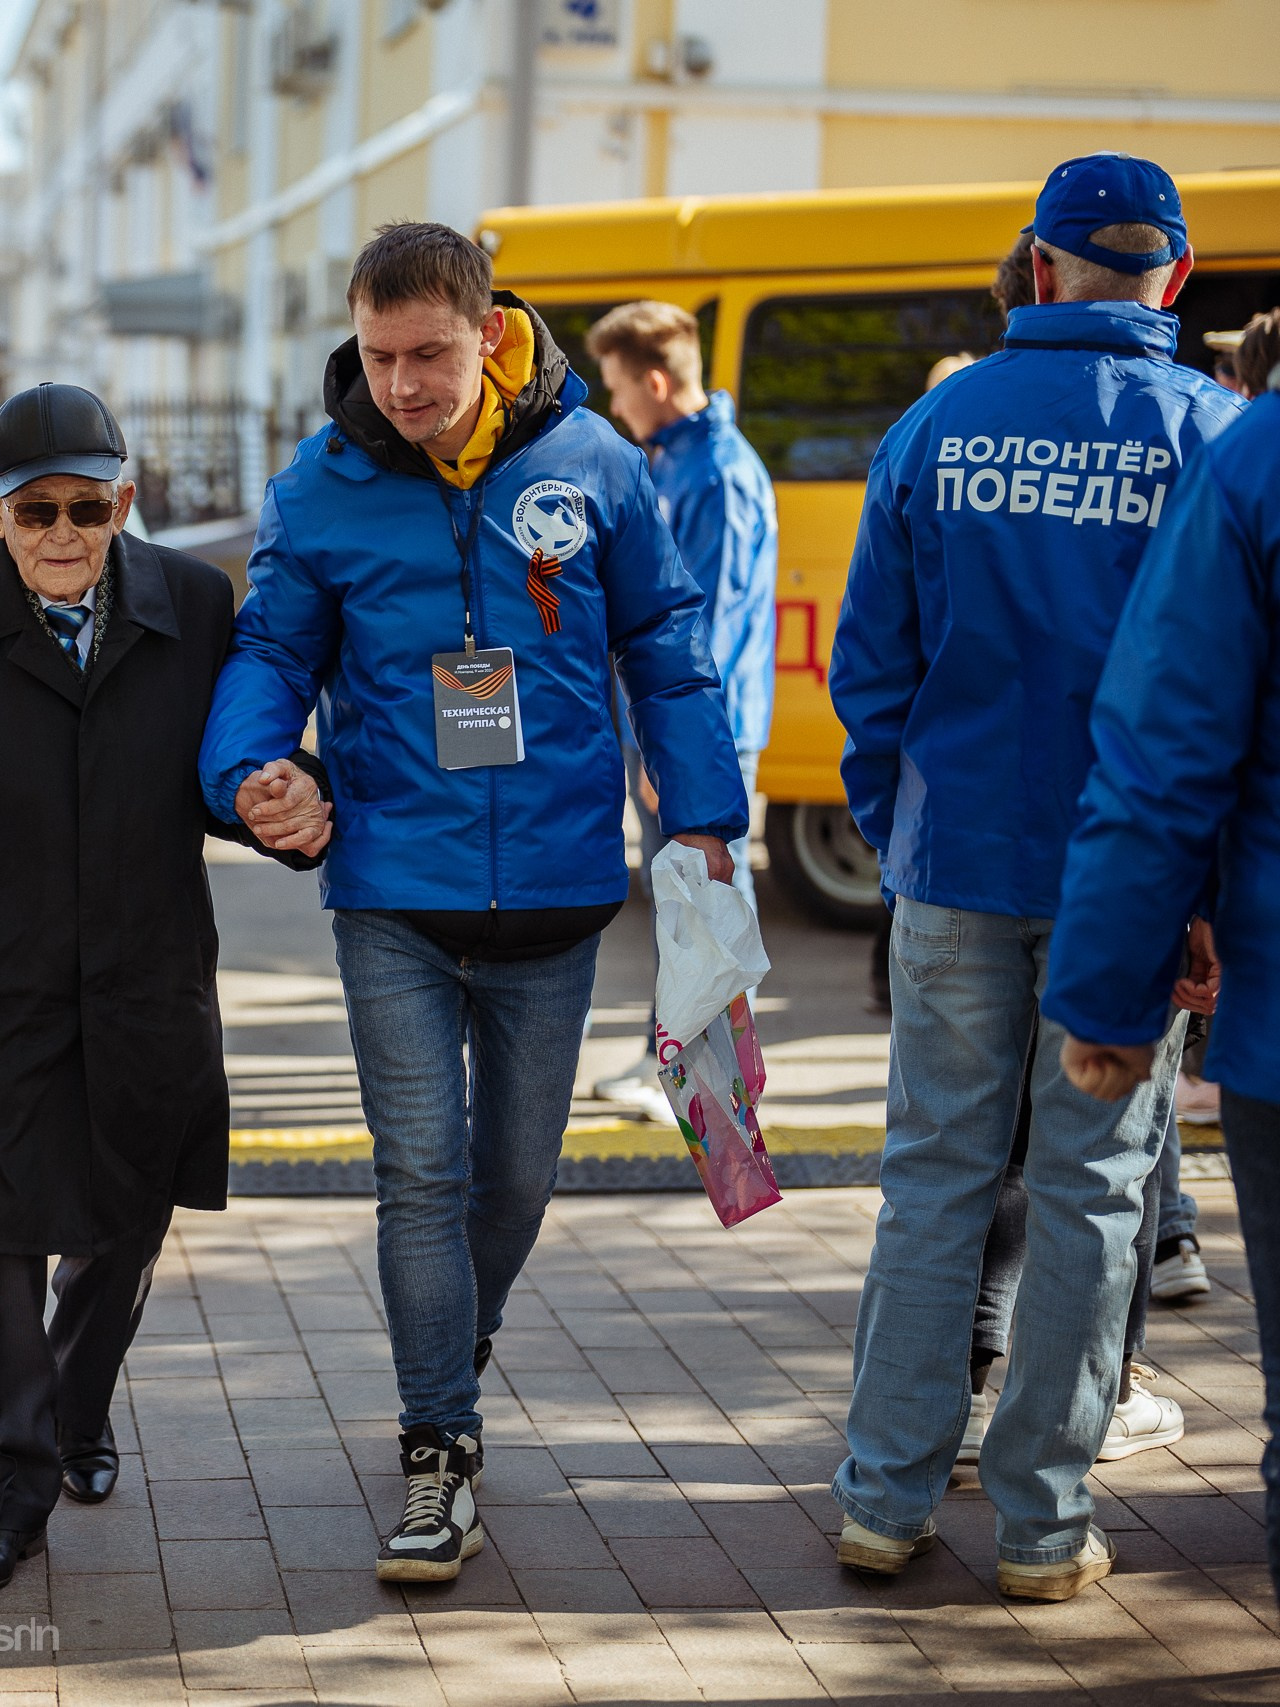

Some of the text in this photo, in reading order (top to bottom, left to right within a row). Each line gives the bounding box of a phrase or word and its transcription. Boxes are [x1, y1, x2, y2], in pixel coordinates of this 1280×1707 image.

[937, 436, 1172, 476] ВОЛОНТЁР
[516, 482, 562, 523] ВОЛОНТЁРЫ
[936, 468, 1167, 528] ПОБЕДЫ
[442, 706, 510, 718] ТЕХНИЧЕСКАЯ
[458, 719, 496, 729] ГРУППА
